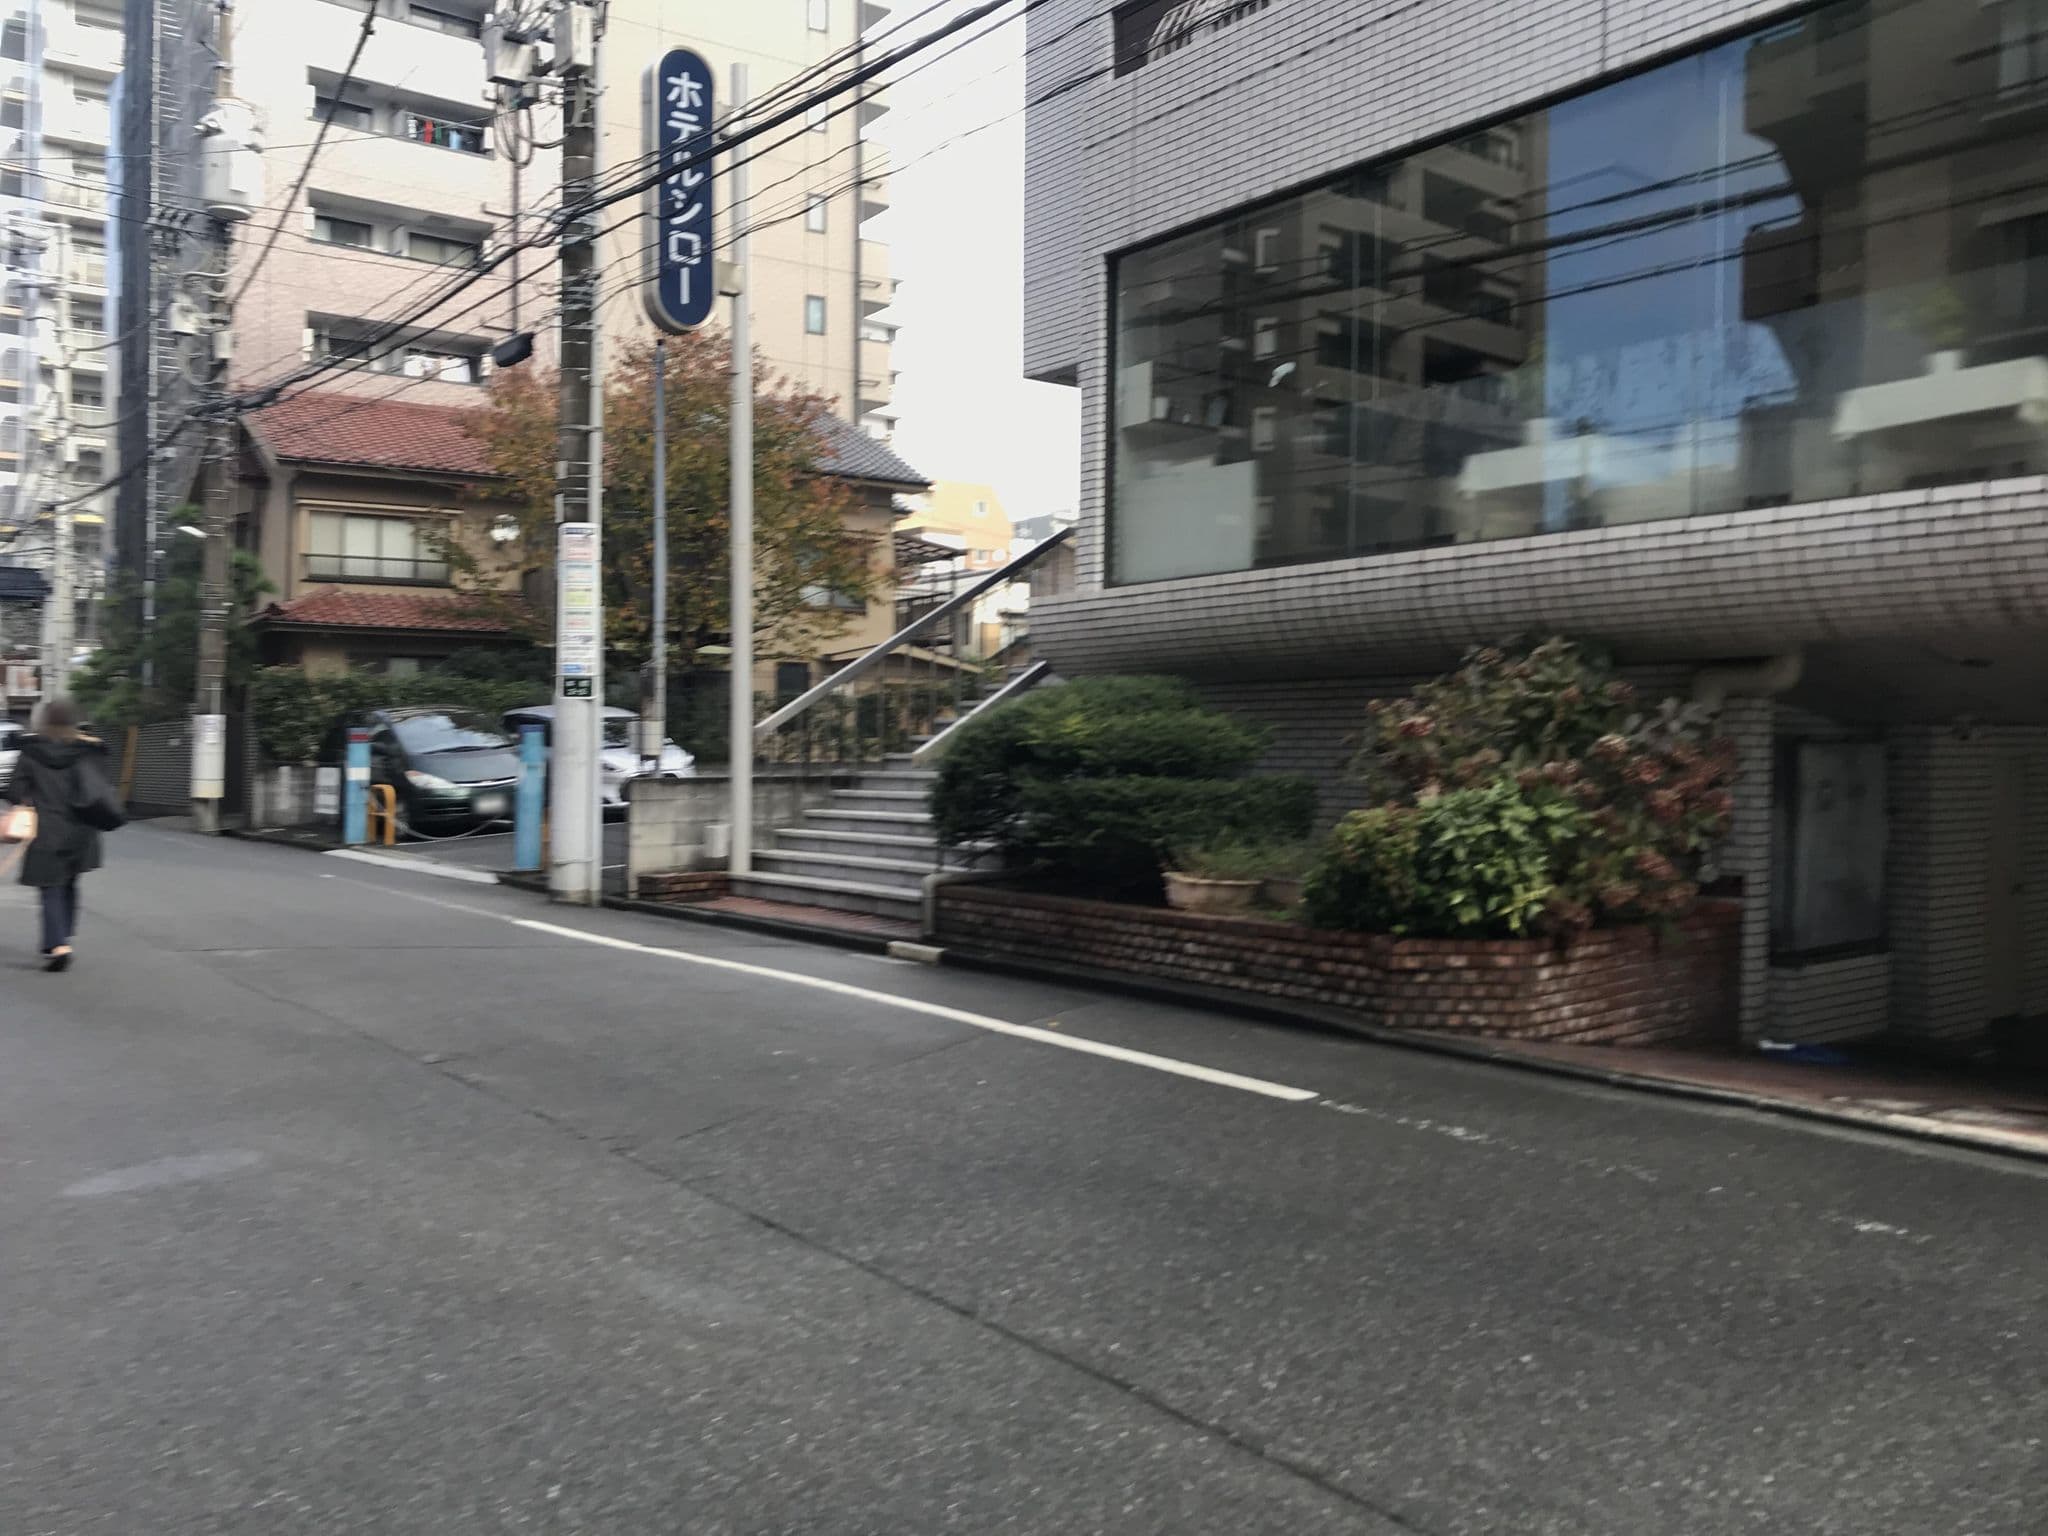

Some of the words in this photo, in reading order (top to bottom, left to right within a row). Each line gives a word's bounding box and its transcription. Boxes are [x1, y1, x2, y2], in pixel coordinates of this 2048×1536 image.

[666, 71, 704, 305] ホテルシロー
